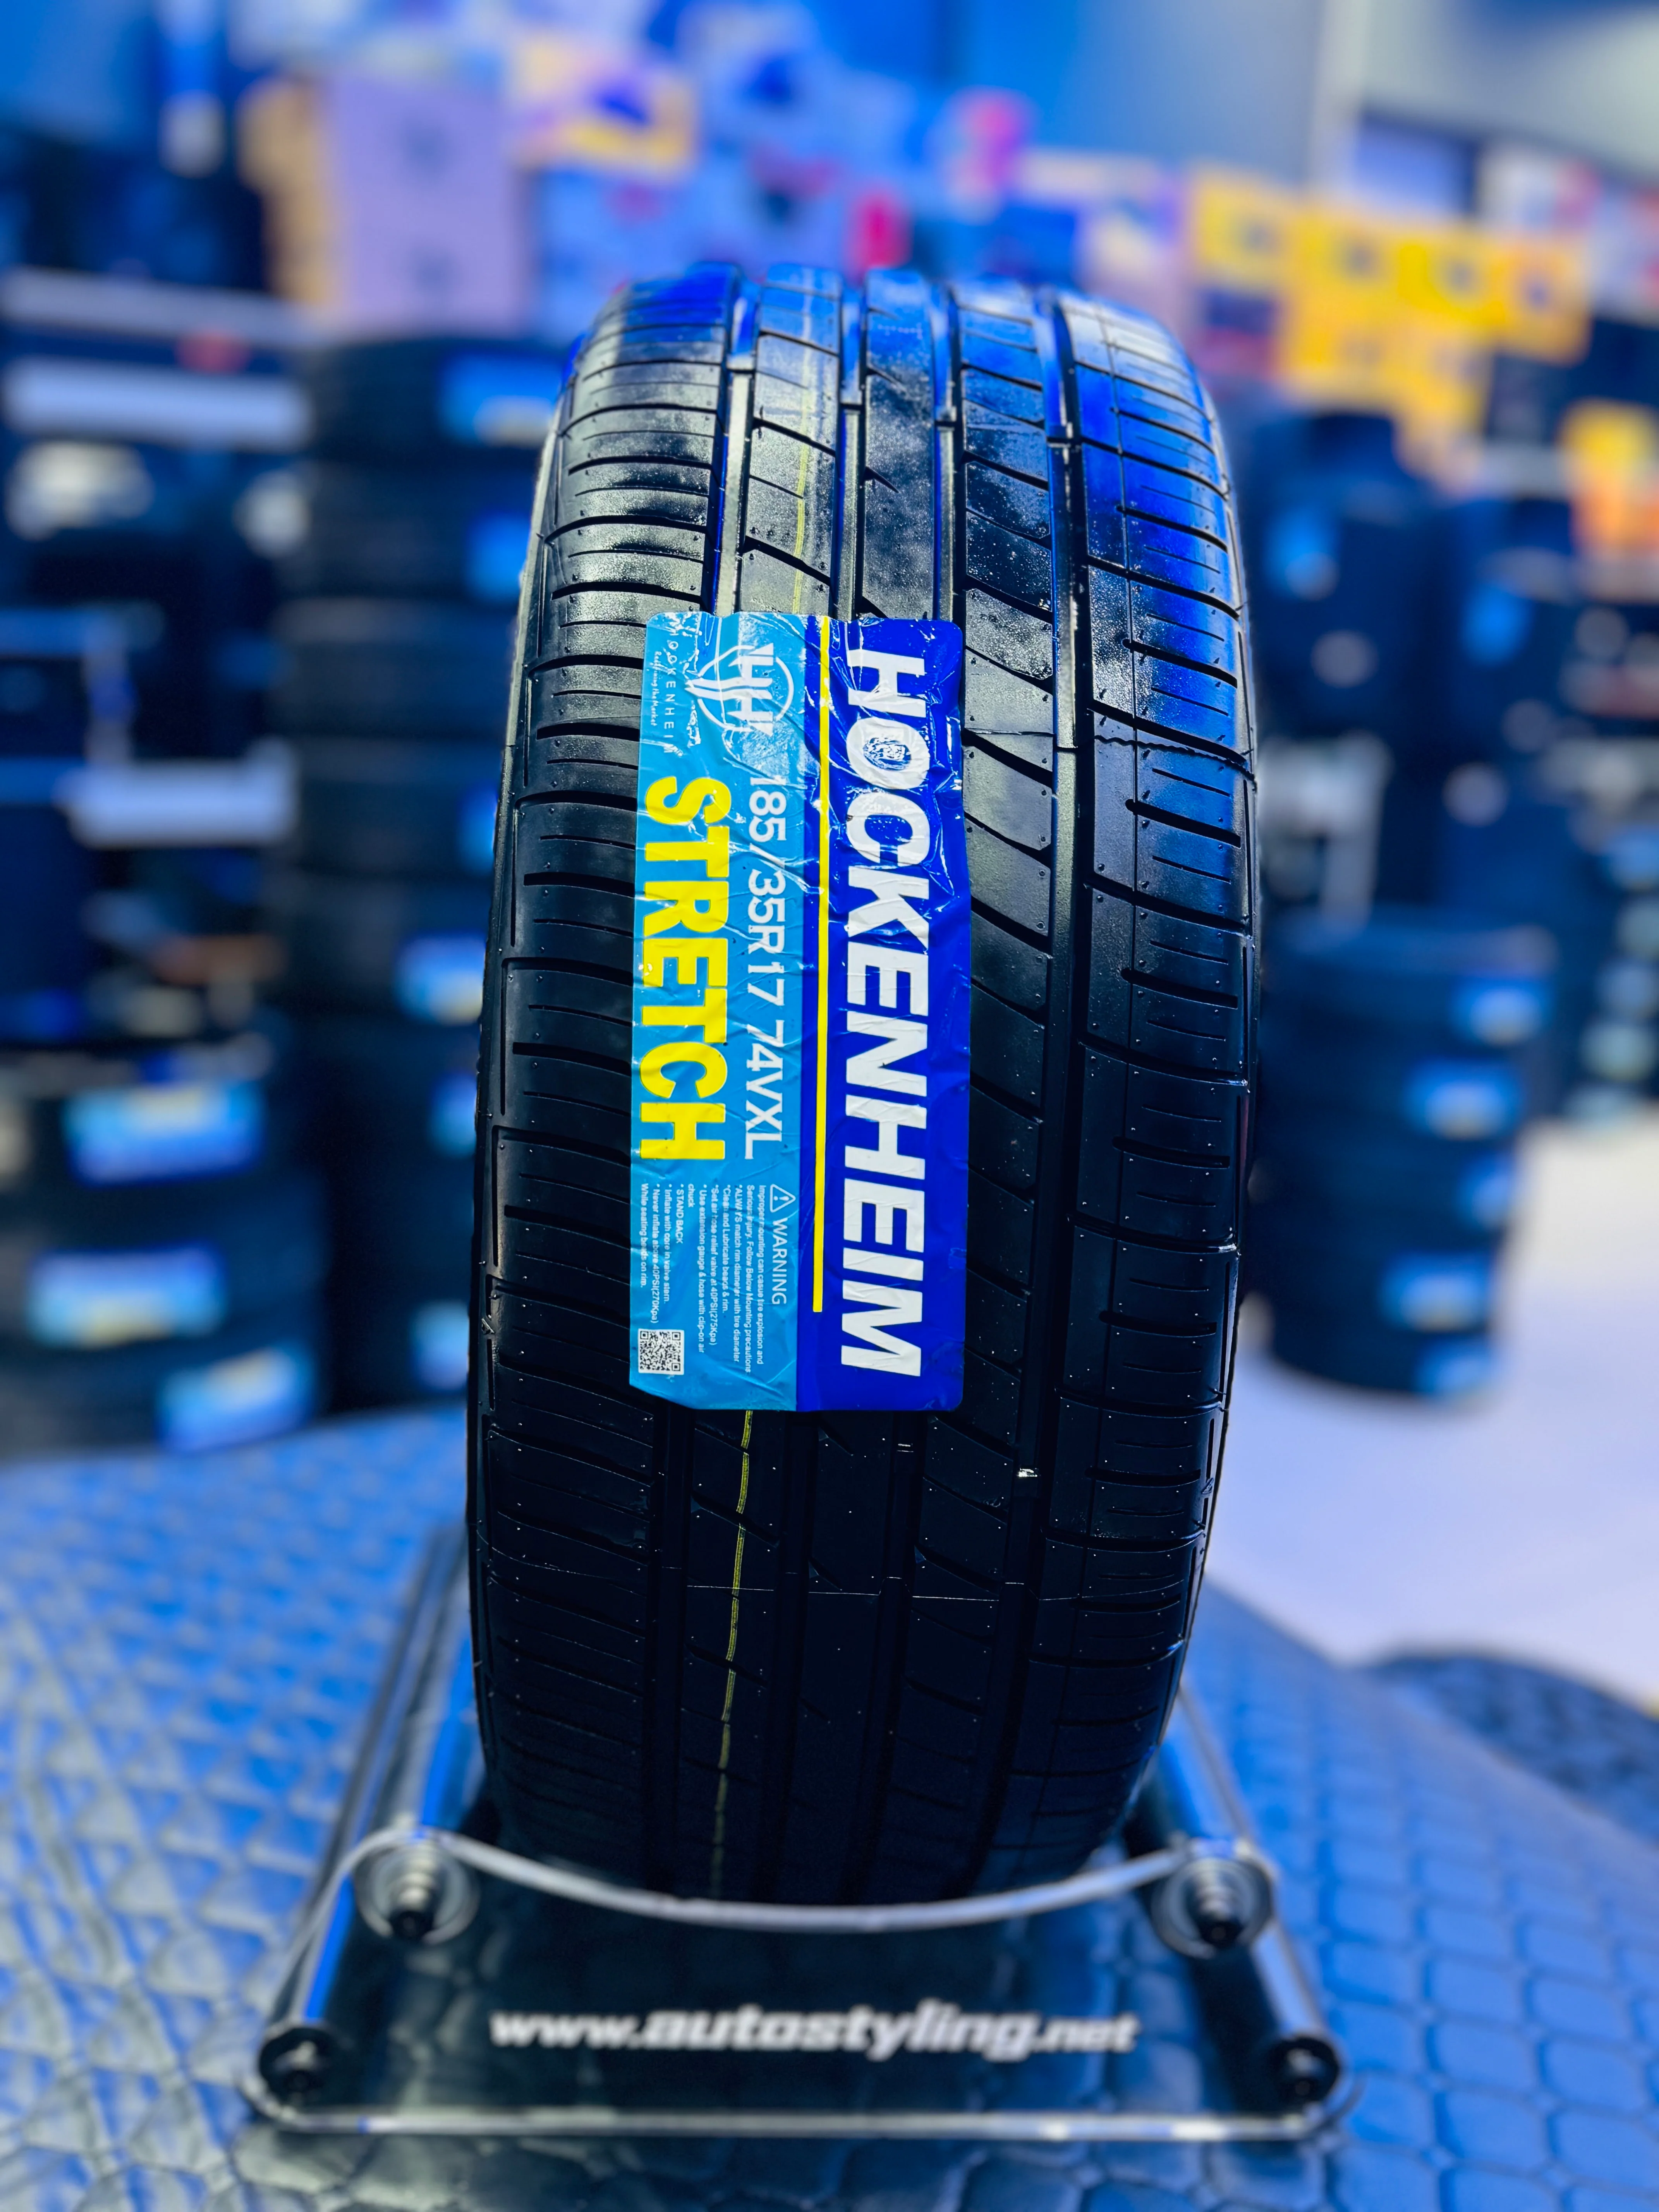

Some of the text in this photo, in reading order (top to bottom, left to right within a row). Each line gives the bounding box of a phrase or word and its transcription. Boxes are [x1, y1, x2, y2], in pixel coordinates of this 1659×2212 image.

[640, 776, 731, 1159] STRETCH
[841, 650, 929, 1376] HOCKENHEIM
[744, 1019, 784, 1159] 74VXL
[664, 1189, 672, 1214] Inflate
[747, 1185, 755, 1215] Serious
[757, 1185, 766, 1220] Improper
[639, 1207, 647, 1236] seating
[675, 1220, 684, 1244] BACK
[640, 1262, 647, 1271] on
[697, 1245, 705, 1270] gauge
[771, 1218, 788, 1305] WARNING
[650, 1264, 659, 1323] 40PSI(270Kpa)
[744, 1293, 753, 1328] Mounting
[697, 1316, 705, 1342] clip-on
[709, 1287, 718, 1345] 40PSI(275Kpa)
[756, 1313, 764, 1349] explosion
[489, 1999, 1140, 2061] www.autostyling.net
